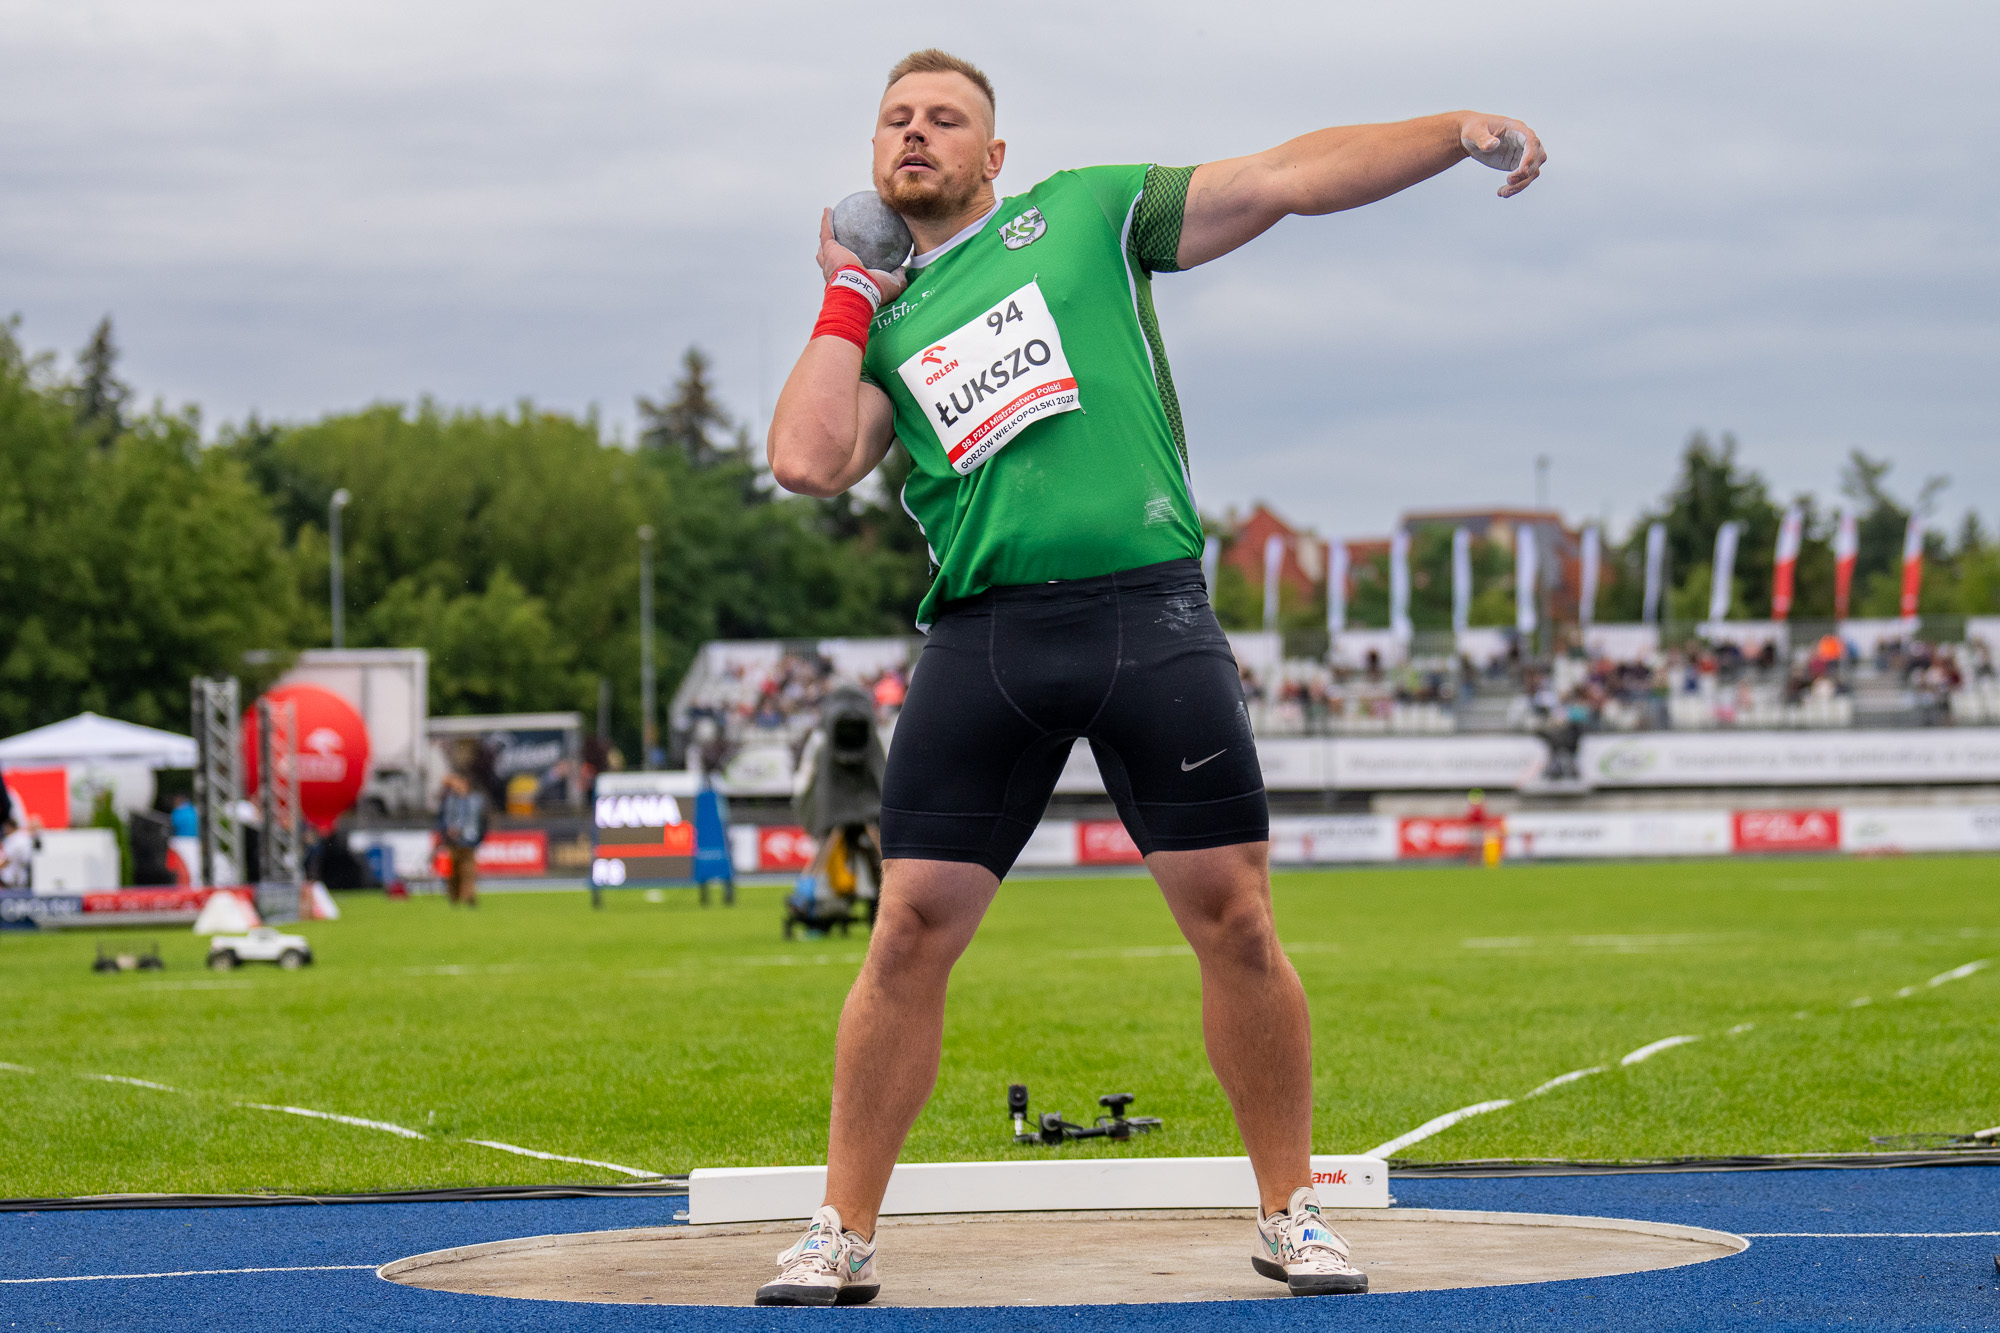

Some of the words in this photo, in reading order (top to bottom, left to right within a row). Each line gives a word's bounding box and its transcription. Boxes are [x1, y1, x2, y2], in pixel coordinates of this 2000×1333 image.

[986, 300, 1023, 336] 94
[925, 359, 959, 386] ORLEN
[935, 339, 1051, 428] ŁUKSZO
[961, 438, 975, 450] 99.
[973, 425, 990, 441] PZLA
[989, 391, 1037, 428] Mistrzostwa
[1036, 382, 1062, 397] Polski
[961, 437, 994, 469] GORZÓW
[993, 399, 1056, 441] WIELKOPOLSKI
[1057, 395, 1075, 406] 2023
[1302, 1229, 1334, 1245] NIKE
